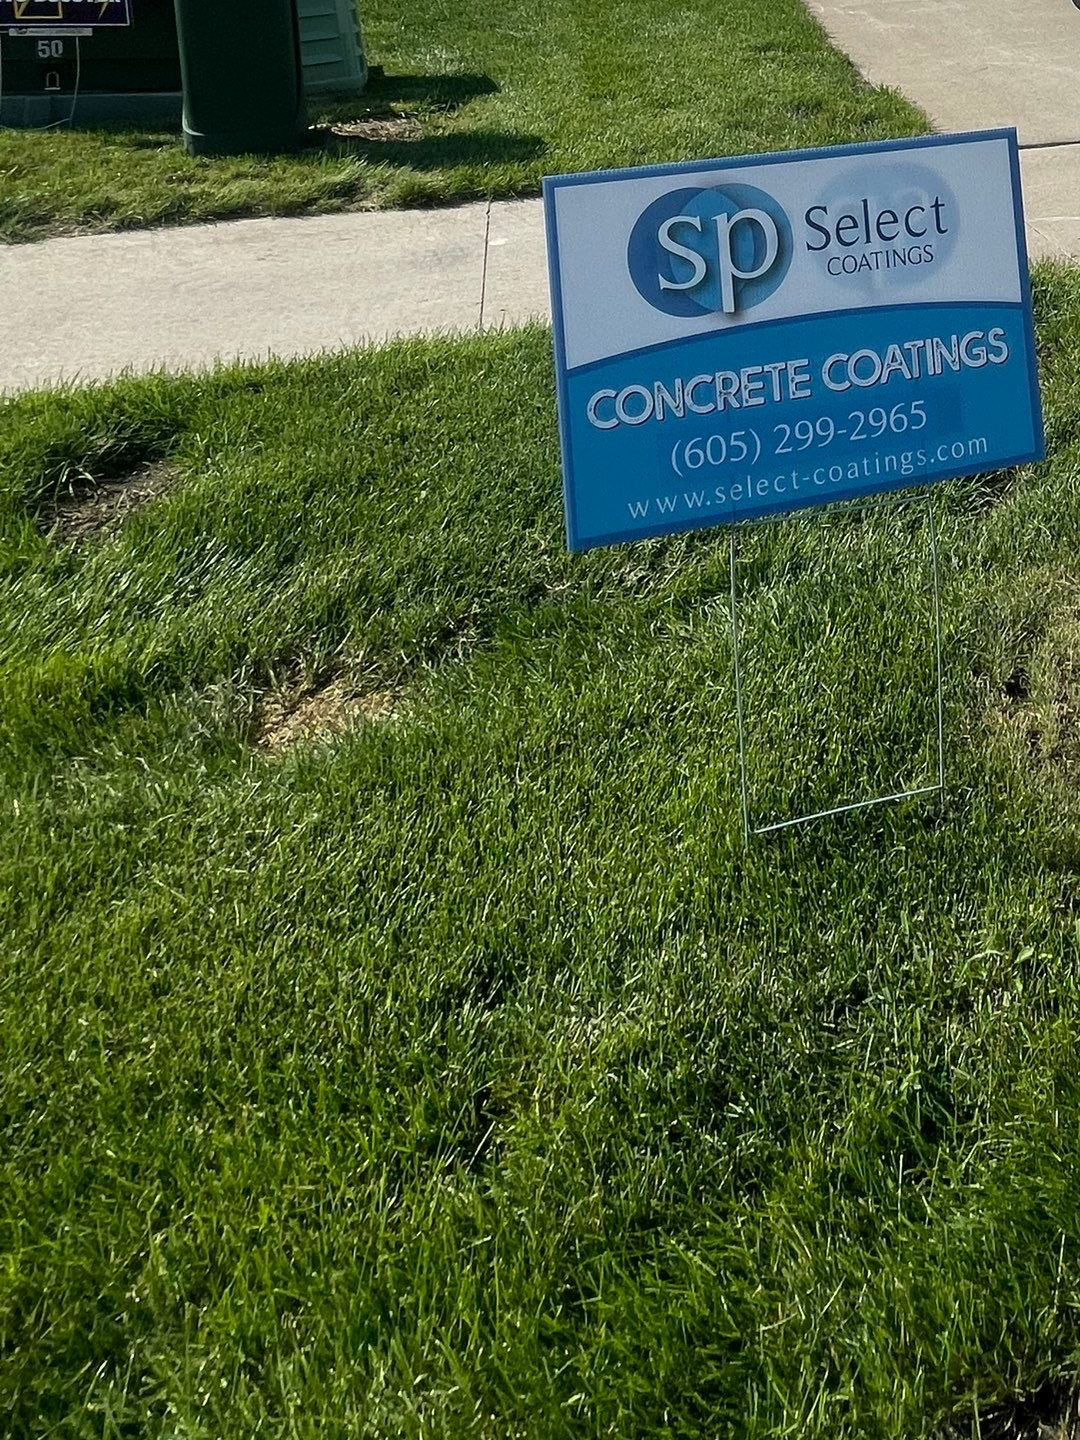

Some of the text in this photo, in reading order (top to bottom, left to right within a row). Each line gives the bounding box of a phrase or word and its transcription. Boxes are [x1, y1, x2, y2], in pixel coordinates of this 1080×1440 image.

[38, 39, 64, 58] 50
[657, 206, 779, 314] sp
[804, 195, 949, 252] Select
[827, 244, 934, 276] COATINGS
[586, 327, 1010, 430] CONCRETE COATINGS
[627, 434, 988, 519] www.select-coatings.com
[671, 400, 928, 478] (605) 299-2965
